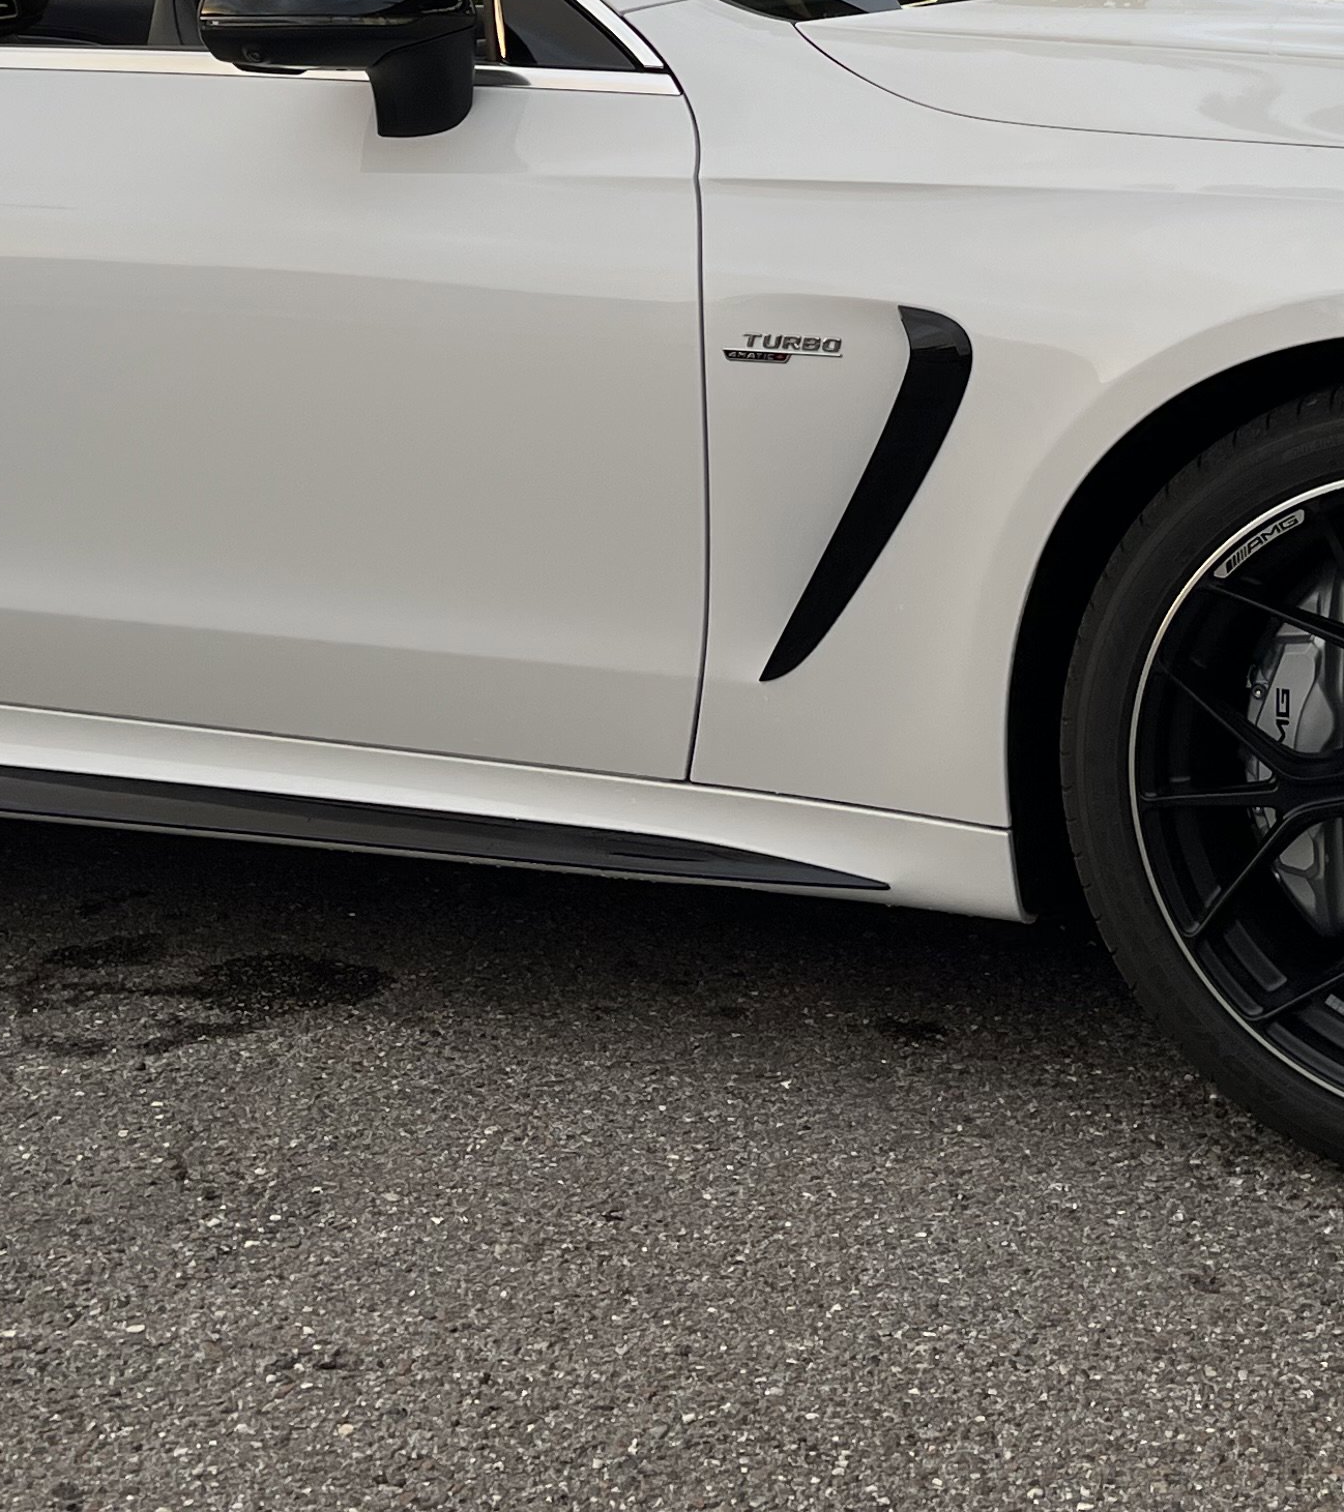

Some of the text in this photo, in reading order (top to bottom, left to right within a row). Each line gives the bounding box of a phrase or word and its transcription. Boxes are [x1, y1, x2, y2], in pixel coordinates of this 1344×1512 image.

[743, 334, 842, 353] TURBO
[1244, 515, 1298, 557] AMG
[1276, 688, 1290, 743] MG
